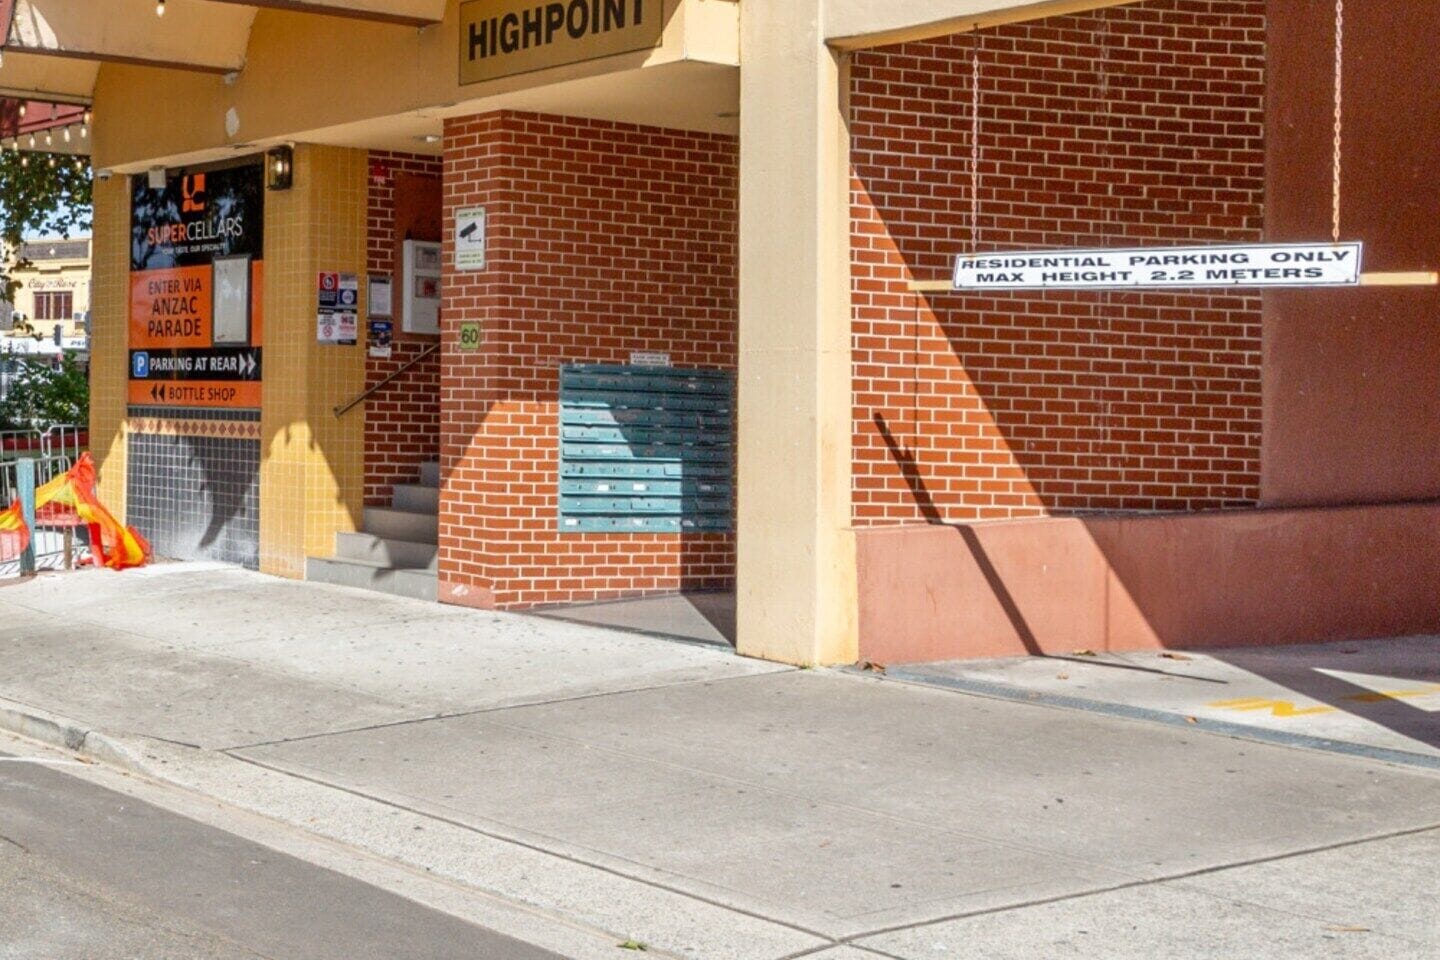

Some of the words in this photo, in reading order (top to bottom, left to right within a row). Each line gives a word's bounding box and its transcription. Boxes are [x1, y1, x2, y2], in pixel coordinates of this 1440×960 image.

[961, 257, 1110, 269] RESIDENTIAL
[1129, 253, 1249, 266] PARKING
[1271, 251, 1350, 263] ONLY
[976, 272, 1024, 282] MAX
[1042, 271, 1132, 282] HEIGHT
[1151, 269, 1195, 280] 2.2
[1206, 267, 1323, 279] METERS
[148, 279, 180, 295] ENTER
[183, 278, 202, 292] VIA
[152, 296, 198, 315] ANZAC
[148, 318, 202, 337] PARADE
[461, 328, 478, 343] 60
[137, 356, 145, 372] P
[150, 356, 192, 371] PARKING
[194, 356, 208, 371] AT
[210, 356, 238, 371] REAR
[169, 387, 205, 401] BOTTLE
[208, 387, 236, 401] SHOP
